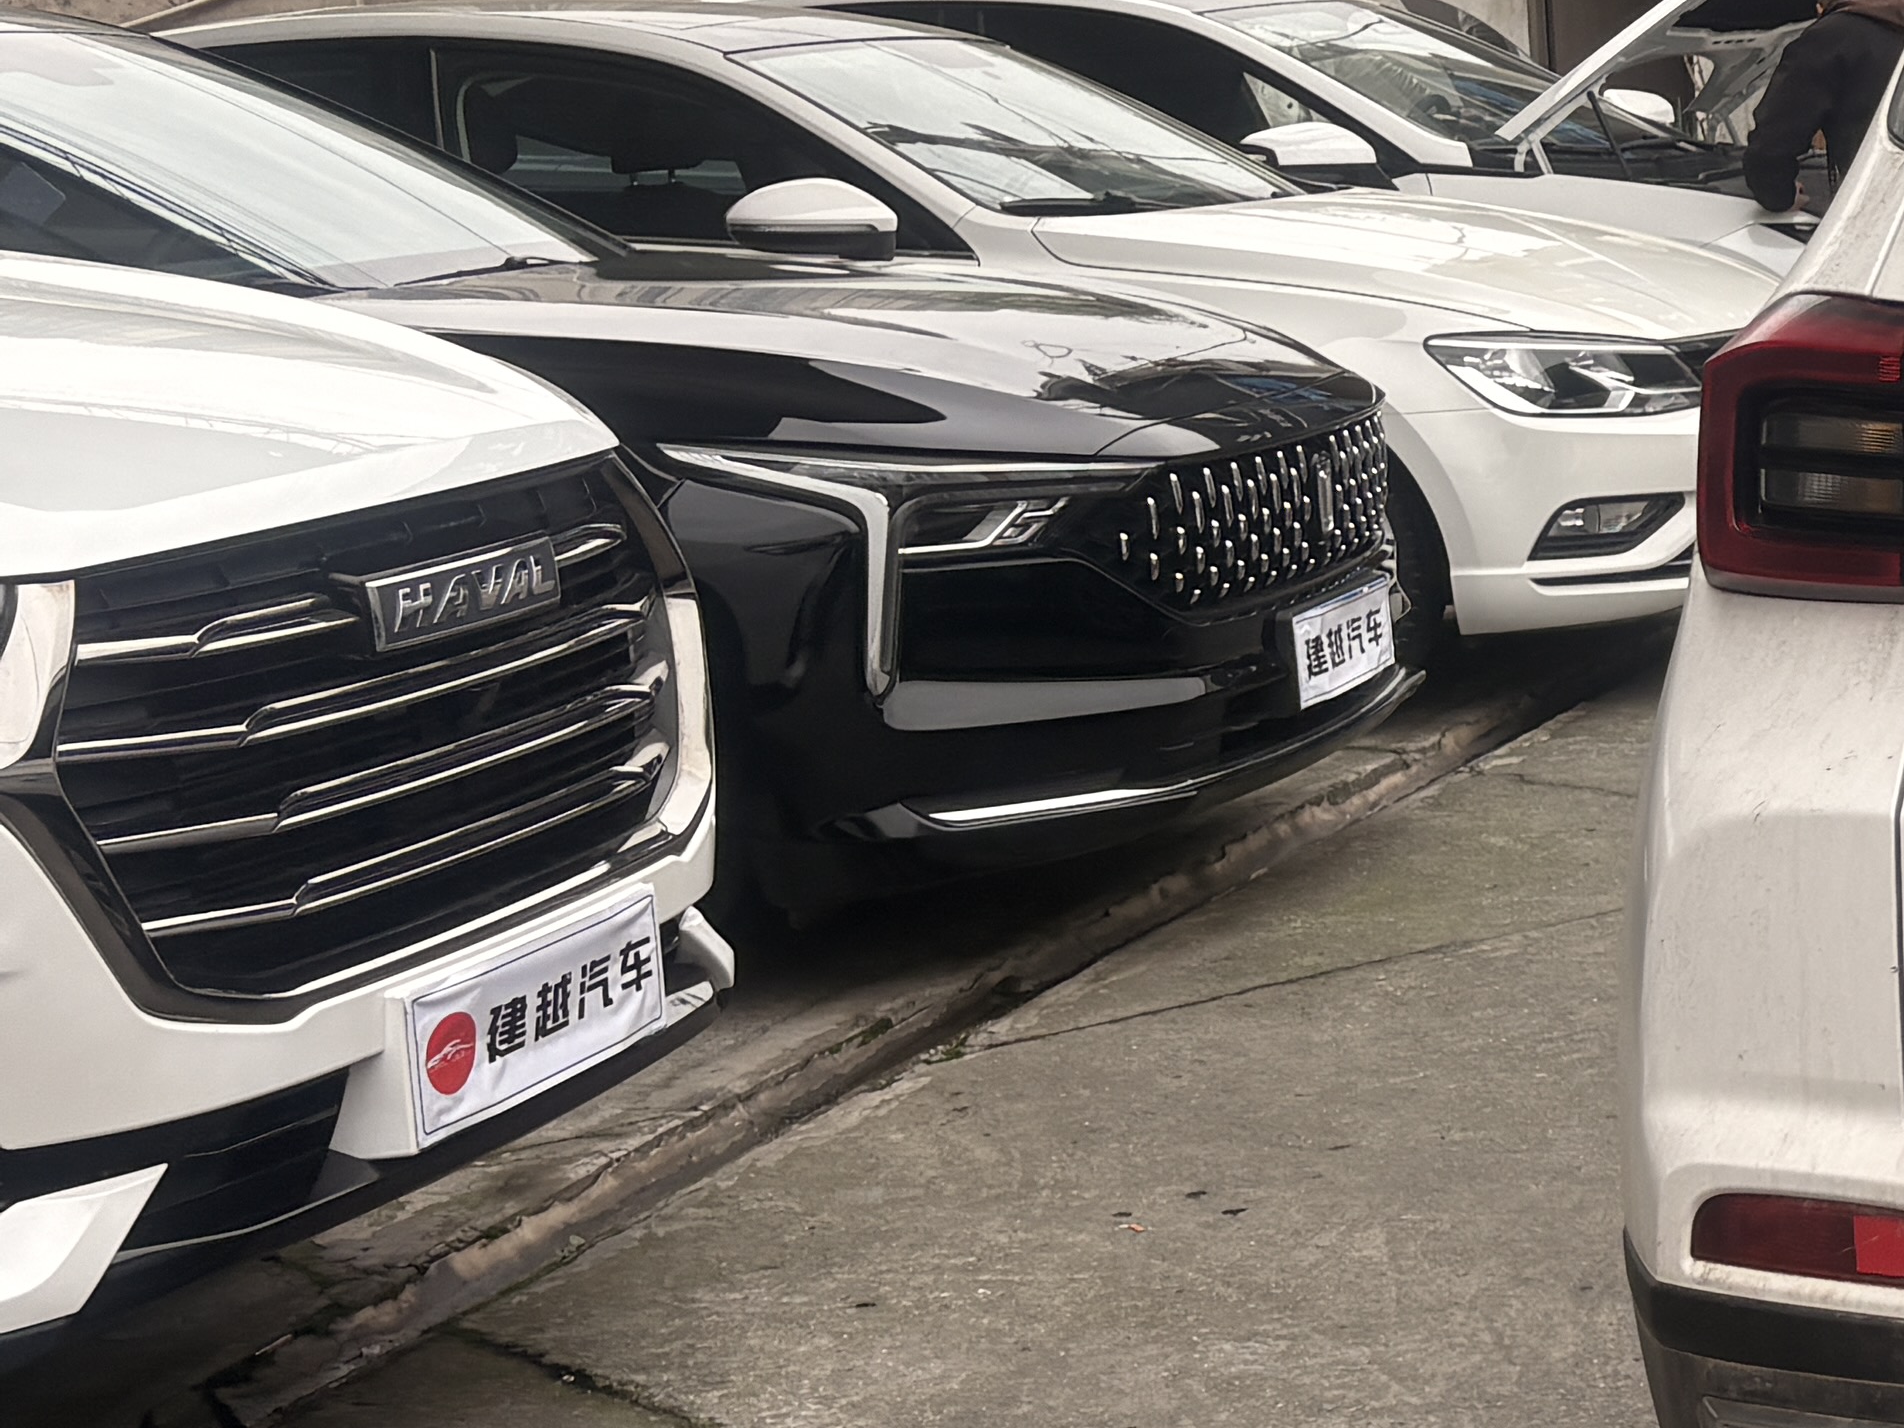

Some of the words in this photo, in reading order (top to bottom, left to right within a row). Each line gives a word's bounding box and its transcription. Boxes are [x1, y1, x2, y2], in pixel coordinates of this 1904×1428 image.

[394, 555, 556, 632] HAVAL
[1304, 607, 1384, 680] 建越汽车
[485, 935, 653, 1064] 建越汽车
